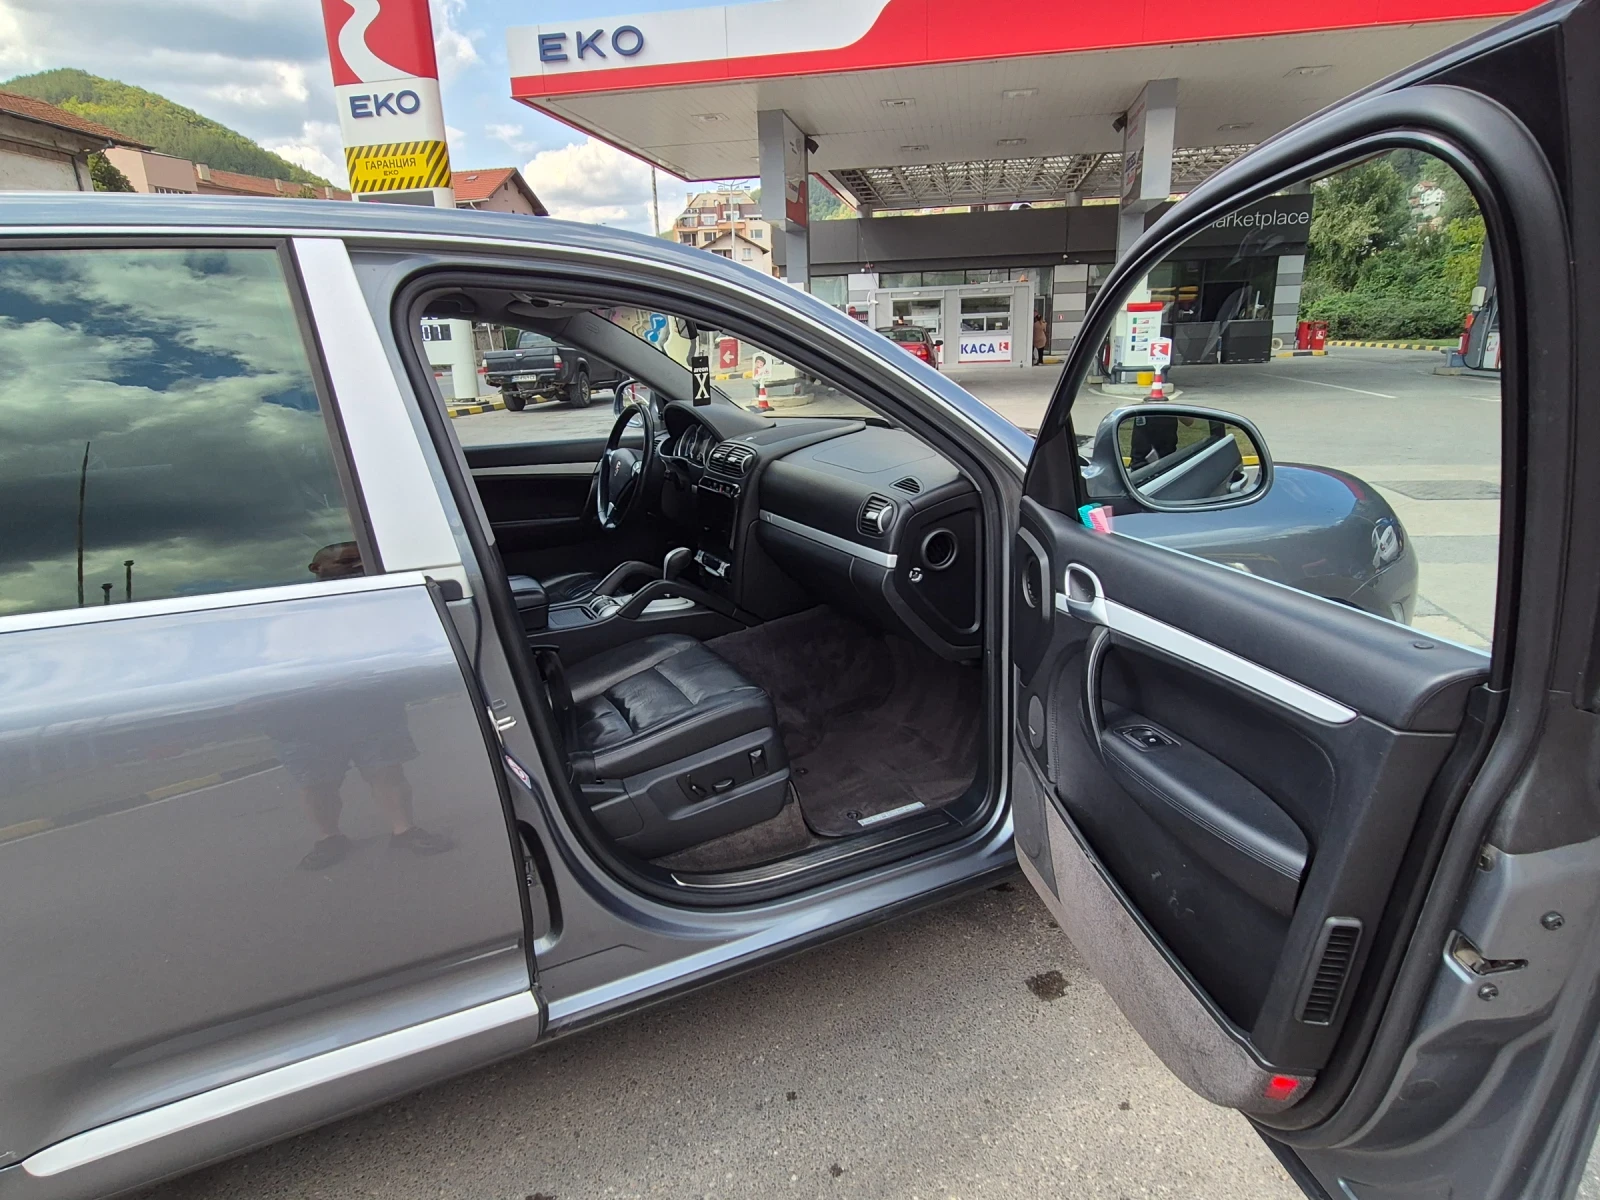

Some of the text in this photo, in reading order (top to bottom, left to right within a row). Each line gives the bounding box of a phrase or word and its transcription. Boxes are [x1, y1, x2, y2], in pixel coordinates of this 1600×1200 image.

[538, 25, 644, 62] EKO
[349, 90, 421, 119] EKO
[365, 157, 417, 170] ГАРАНЦИЯ
[960, 343, 996, 354] КАСА
[694, 372, 710, 400] X
